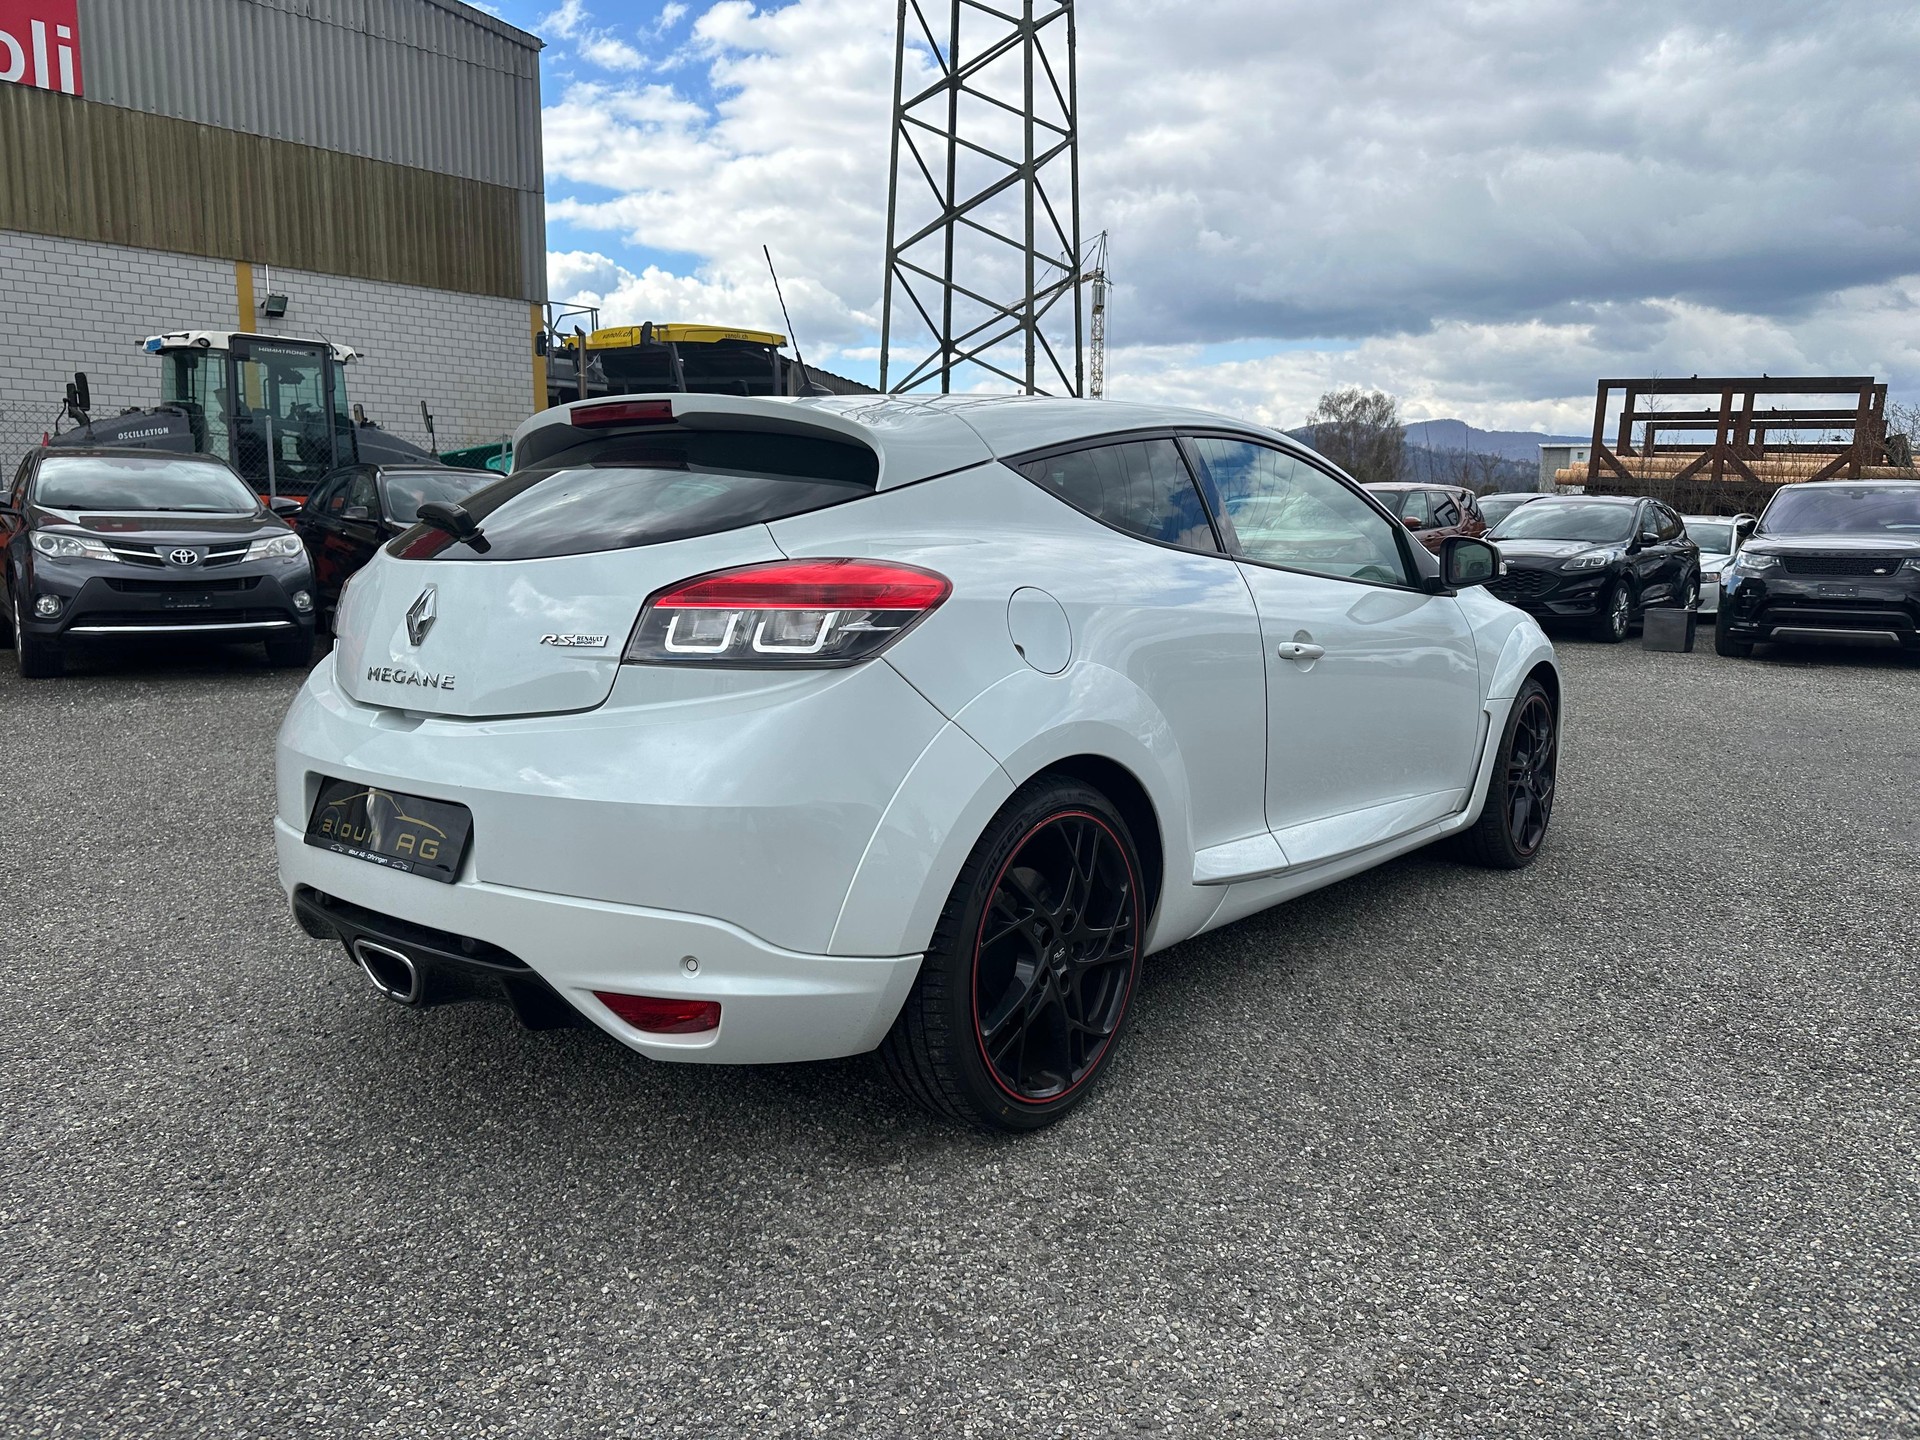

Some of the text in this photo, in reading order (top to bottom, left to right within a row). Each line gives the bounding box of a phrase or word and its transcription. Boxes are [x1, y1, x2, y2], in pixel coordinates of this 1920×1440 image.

[602, 330, 632, 339] vanoli.ch
[258, 347, 308, 356] HAMMTRONIC
[117, 427, 169, 440] OSCILLATION
[367, 666, 455, 690] MEGANE
[396, 833, 440, 860] AG
